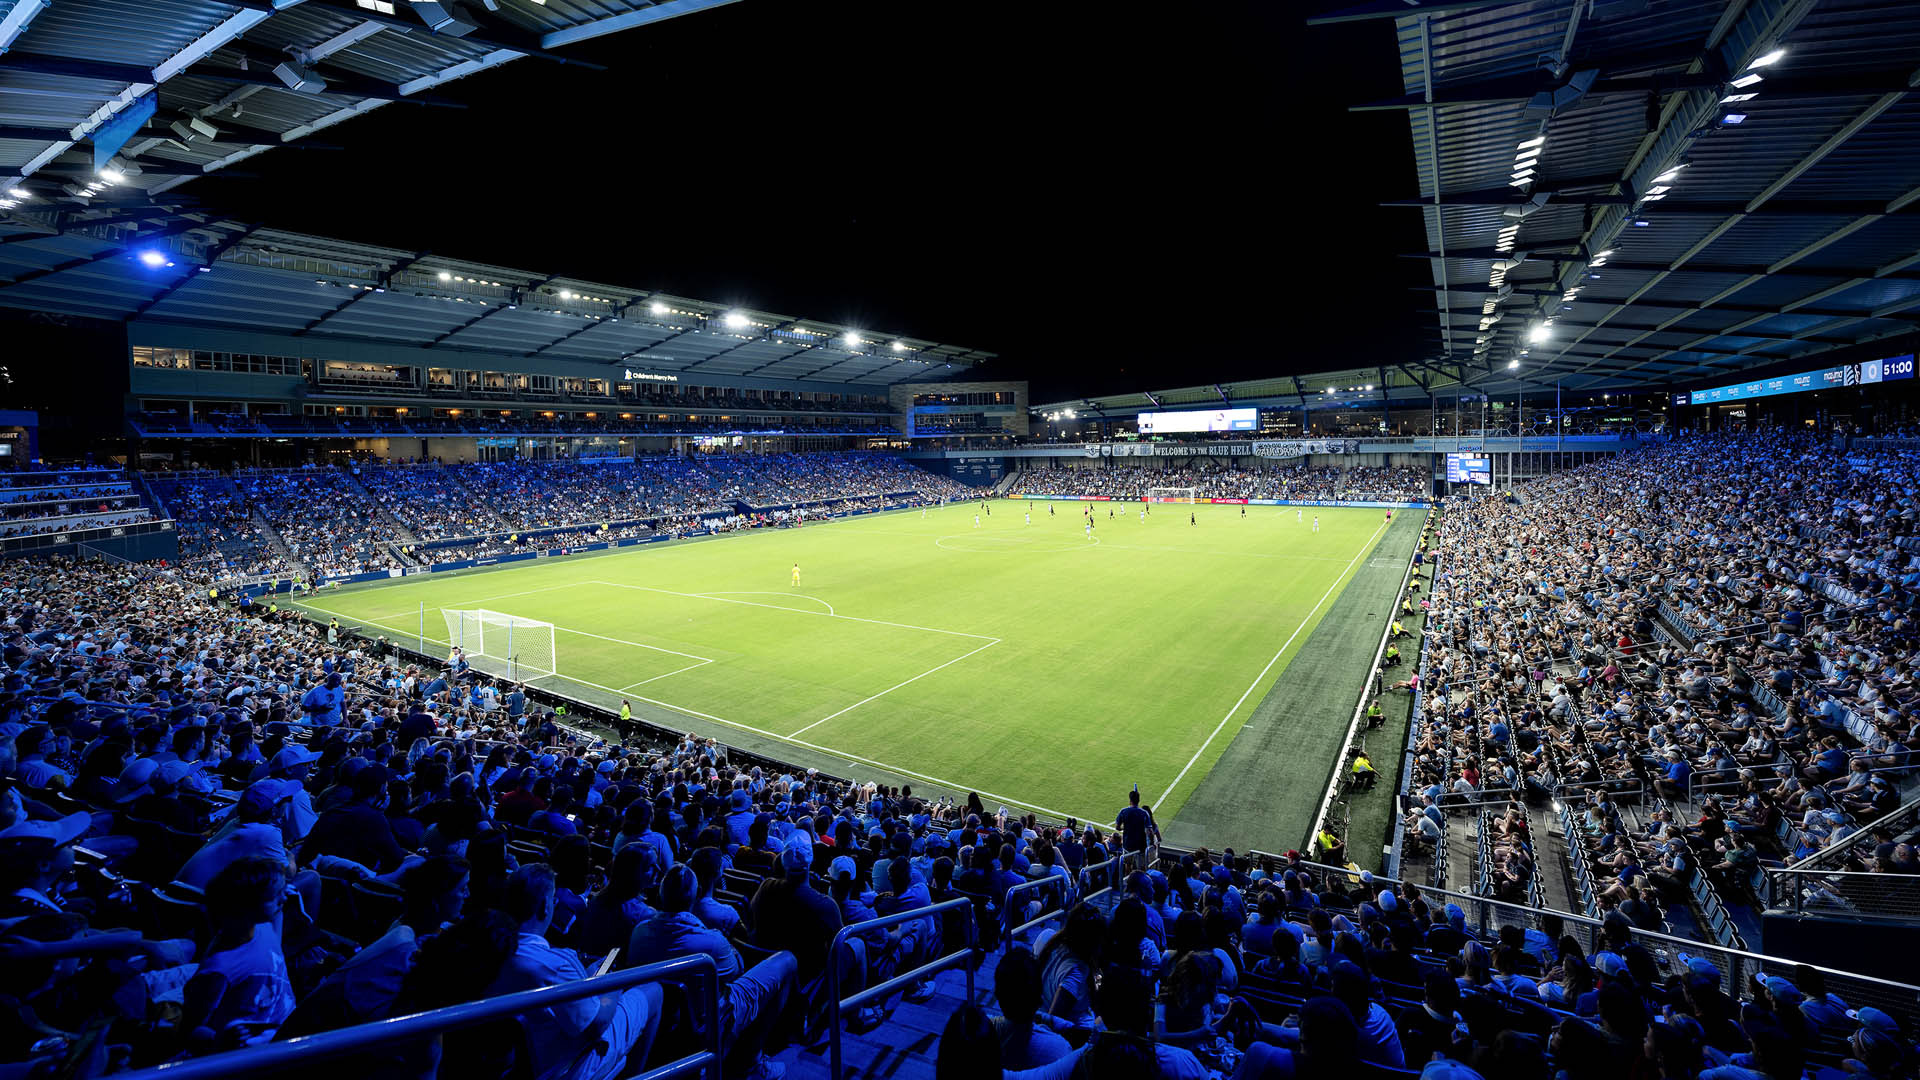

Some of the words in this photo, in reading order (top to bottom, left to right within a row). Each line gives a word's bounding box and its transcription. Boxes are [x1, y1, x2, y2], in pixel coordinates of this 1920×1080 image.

[1868, 364, 1877, 379] 0
[1884, 361, 1912, 375] 51:00
[1155, 447, 1188, 455] WELCOME
[1197, 447, 1207, 455] THE
[1209, 446, 1228, 455] BLUE
[1231, 446, 1250, 455] HELL
[1255, 446, 1303, 457] CAULDRON
